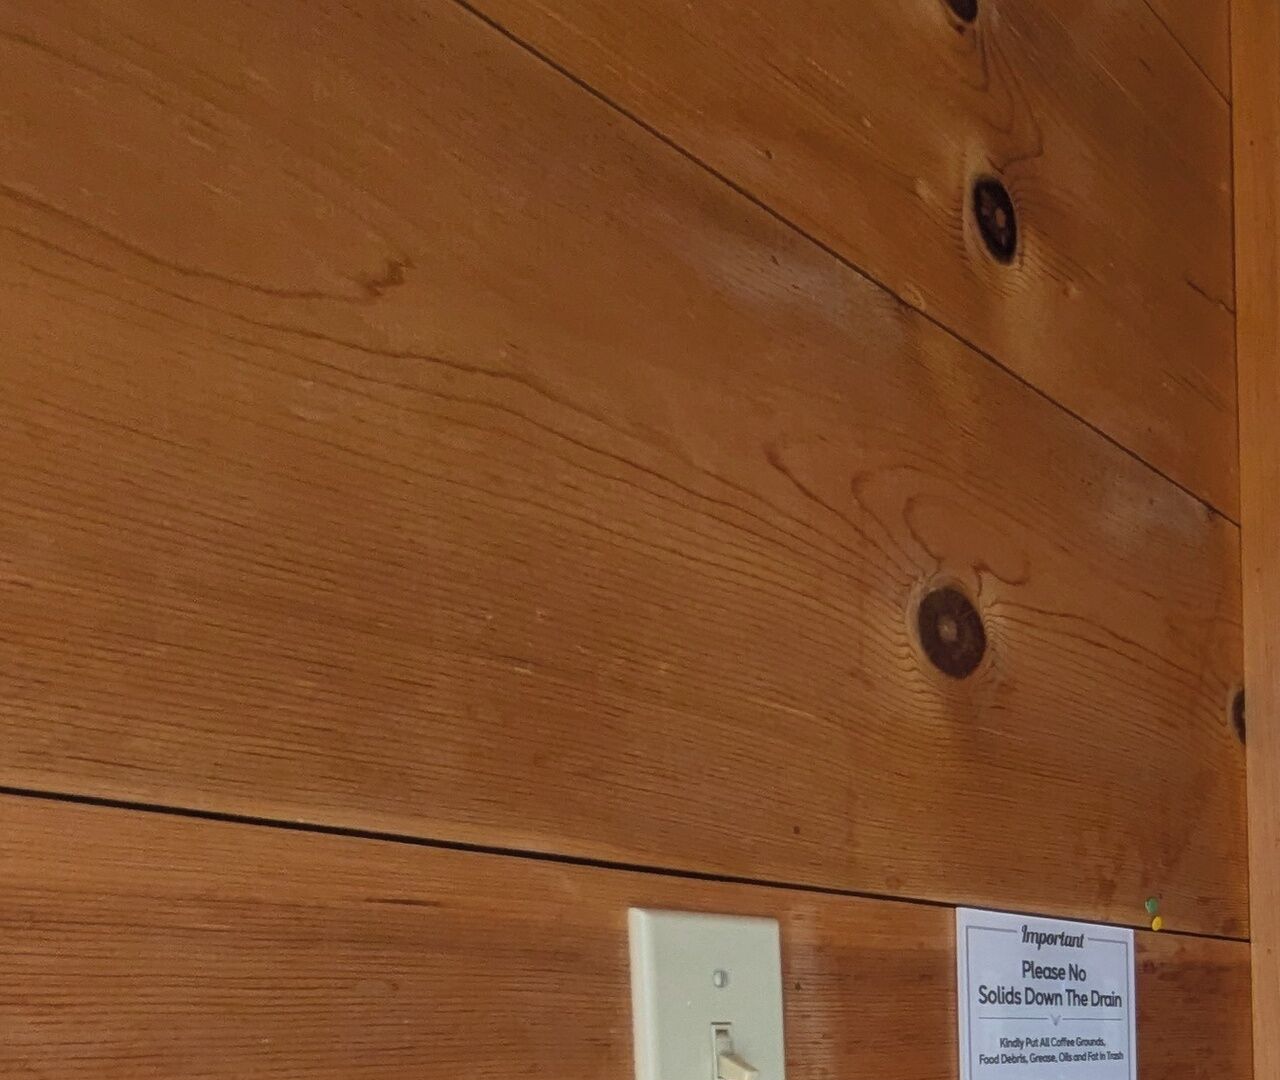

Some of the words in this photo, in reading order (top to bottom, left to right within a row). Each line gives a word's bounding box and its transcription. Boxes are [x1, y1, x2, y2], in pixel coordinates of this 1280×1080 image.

[1021, 924, 1085, 950] Important
[1022, 960, 1066, 981] Please
[1068, 963, 1087, 982] No
[978, 985, 1022, 1005] Solids
[1024, 987, 1063, 1006] Down
[1065, 988, 1088, 1007] The
[1091, 991, 1122, 1008] Drain
[1000, 1037, 1024, 1050] Kindly
[1026, 1037, 1039, 1048] Put
[1040, 1037, 1050, 1048] All
[1051, 1036, 1075, 1047] Coffee
[979, 1053, 1000, 1065] Food
[1029, 1052, 1058, 1063] Grease,
[1073, 1051, 1087, 1061] and
[1087, 1051, 1099, 1061] Fat
[1106, 1050, 1124, 1060] Trash
